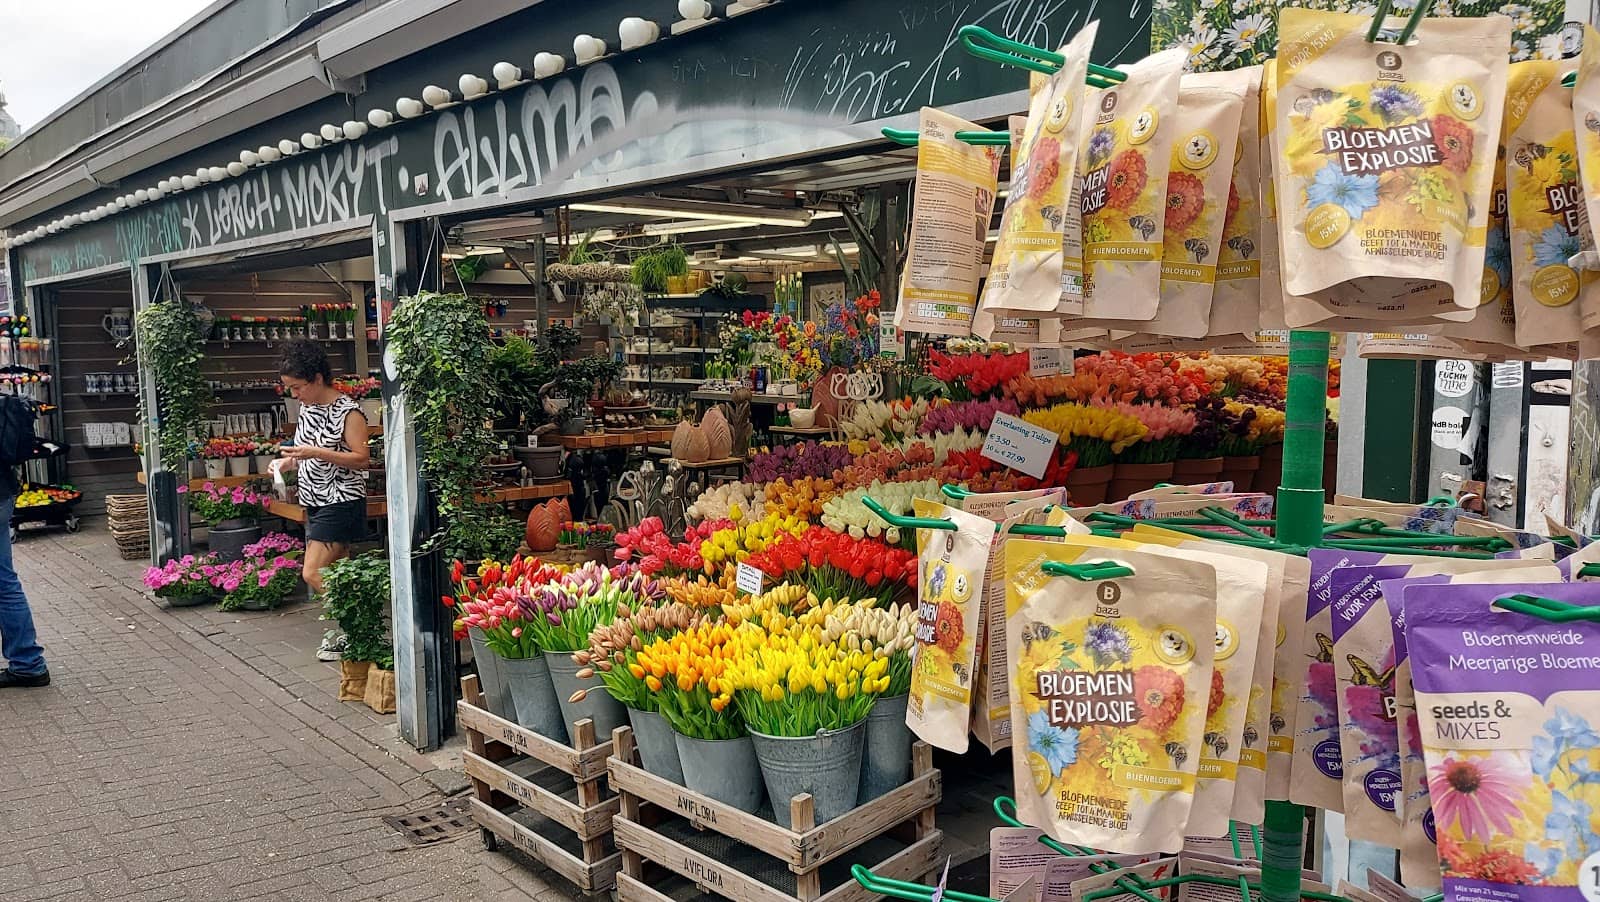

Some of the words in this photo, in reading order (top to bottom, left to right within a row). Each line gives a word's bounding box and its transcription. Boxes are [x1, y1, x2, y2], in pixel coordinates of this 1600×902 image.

[1326, 122, 1432, 151] BLOEMEN
[1343, 144, 1438, 172] EXPLOSIE
[1082, 189, 1106, 213] OSIE
[1565, 210, 1579, 232] E
[1366, 229, 1442, 241] BLOEMENWEIDE
[995, 417, 1030, 438] Everlasting
[1031, 430, 1052, 445] Tulips
[1334, 593, 1352, 610] ZADEN
[1350, 574, 1374, 596] STROOIEN
[1096, 604, 1119, 615] baza
[1340, 598, 1365, 621] VOOR
[1462, 630, 1584, 647] Bloemenweide
[1449, 654, 1538, 673] Meerjarige
[1540, 653, 1600, 669] Bloeme
[1040, 674, 1133, 697] BLOEMEN
[1052, 699, 1136, 724] EXPLOSIE
[1432, 701, 1490, 719] seeds
[1494, 700, 1512, 717] &
[1436, 722, 1500, 740] MIXES
[678, 795, 717, 824] AVIFLORA
[1055, 801, 1074, 811] GEEFT
[1096, 806, 1132, 821] MAANDEN
[1061, 791, 1128, 810] BLOEMENWEIDE
[1058, 811, 1108, 828] AFWISSELENDE
[1108, 820, 1128, 830] BLOEI
[684, 857, 723, 889] AVIFLORA
